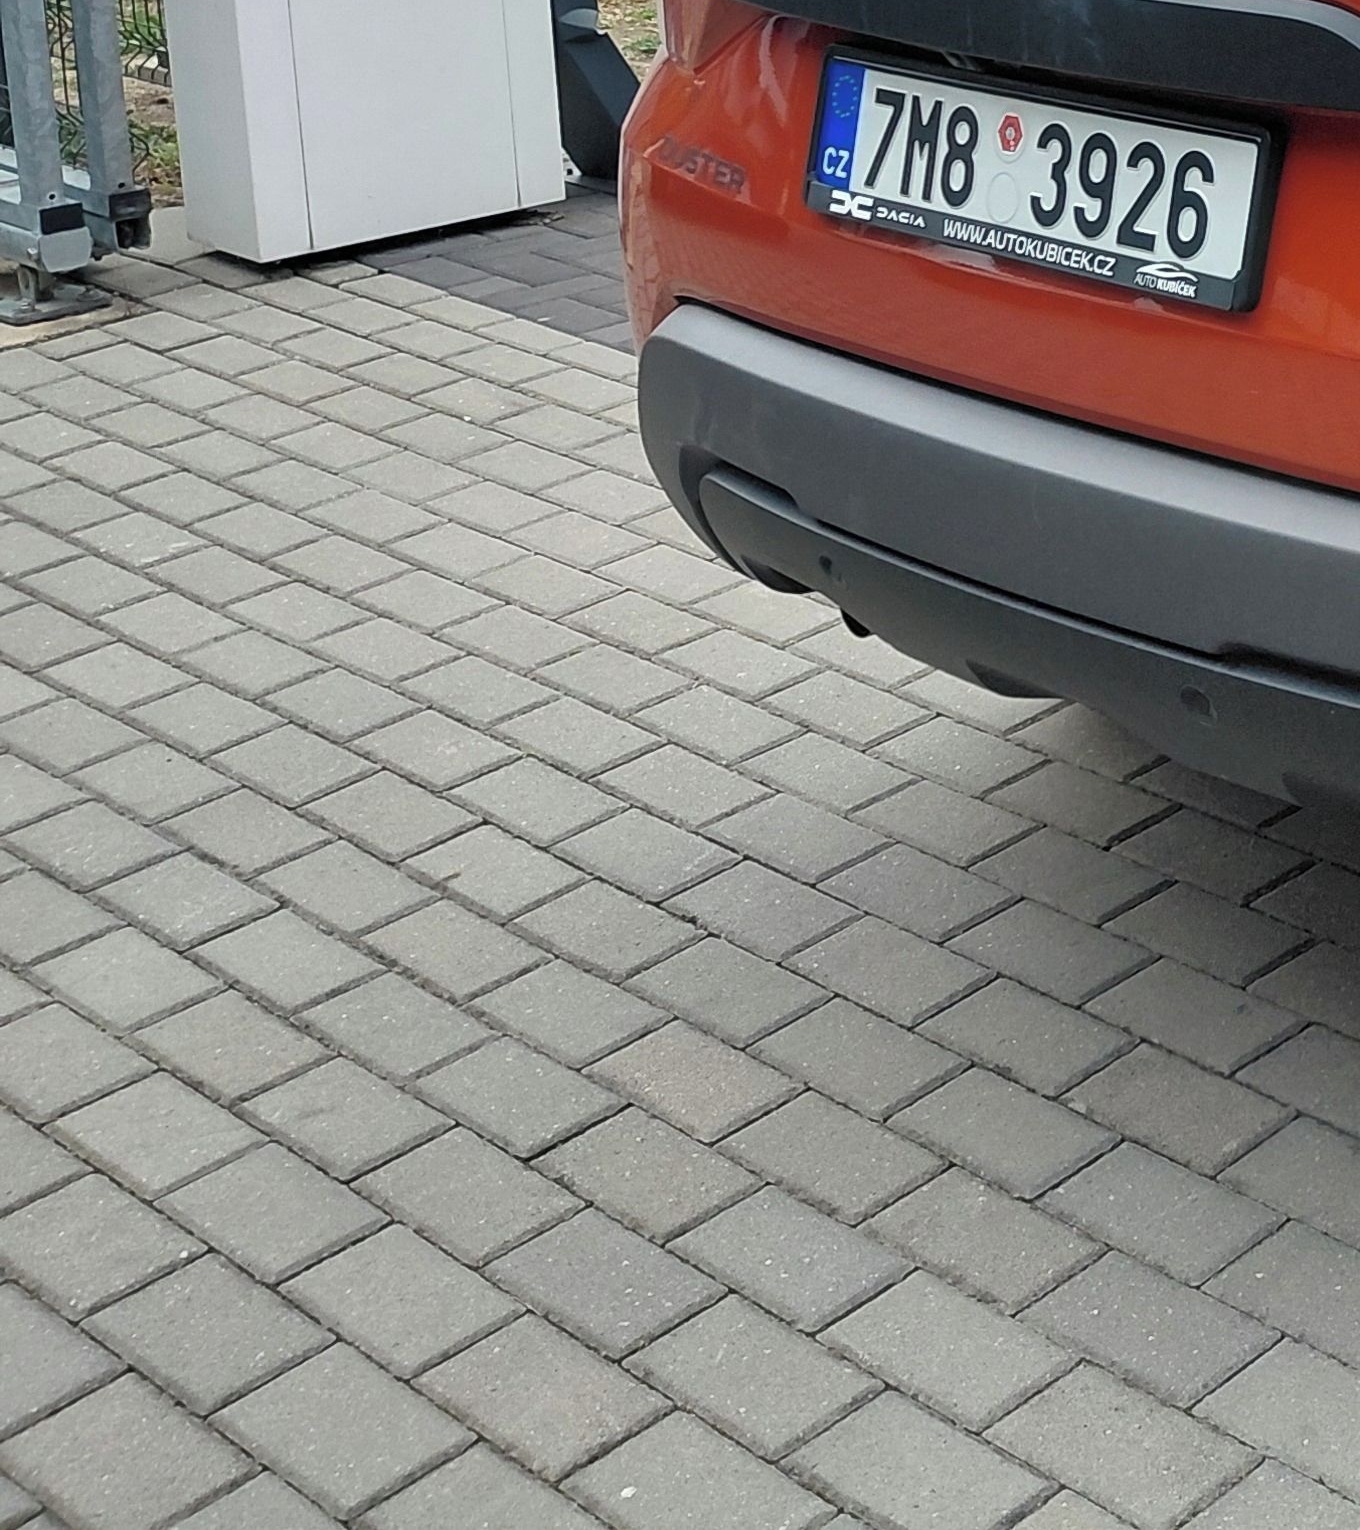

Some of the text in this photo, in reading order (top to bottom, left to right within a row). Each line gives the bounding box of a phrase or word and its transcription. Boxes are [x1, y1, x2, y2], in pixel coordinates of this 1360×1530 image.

[822, 147, 850, 178] CZ
[864, 88, 1215, 259] 7M8 3926
[876, 207, 926, 228] DACIA
[943, 218, 1117, 277] WWW.AUTOKUBICEK.CZ
[1134, 273, 1157, 288] AUTO
